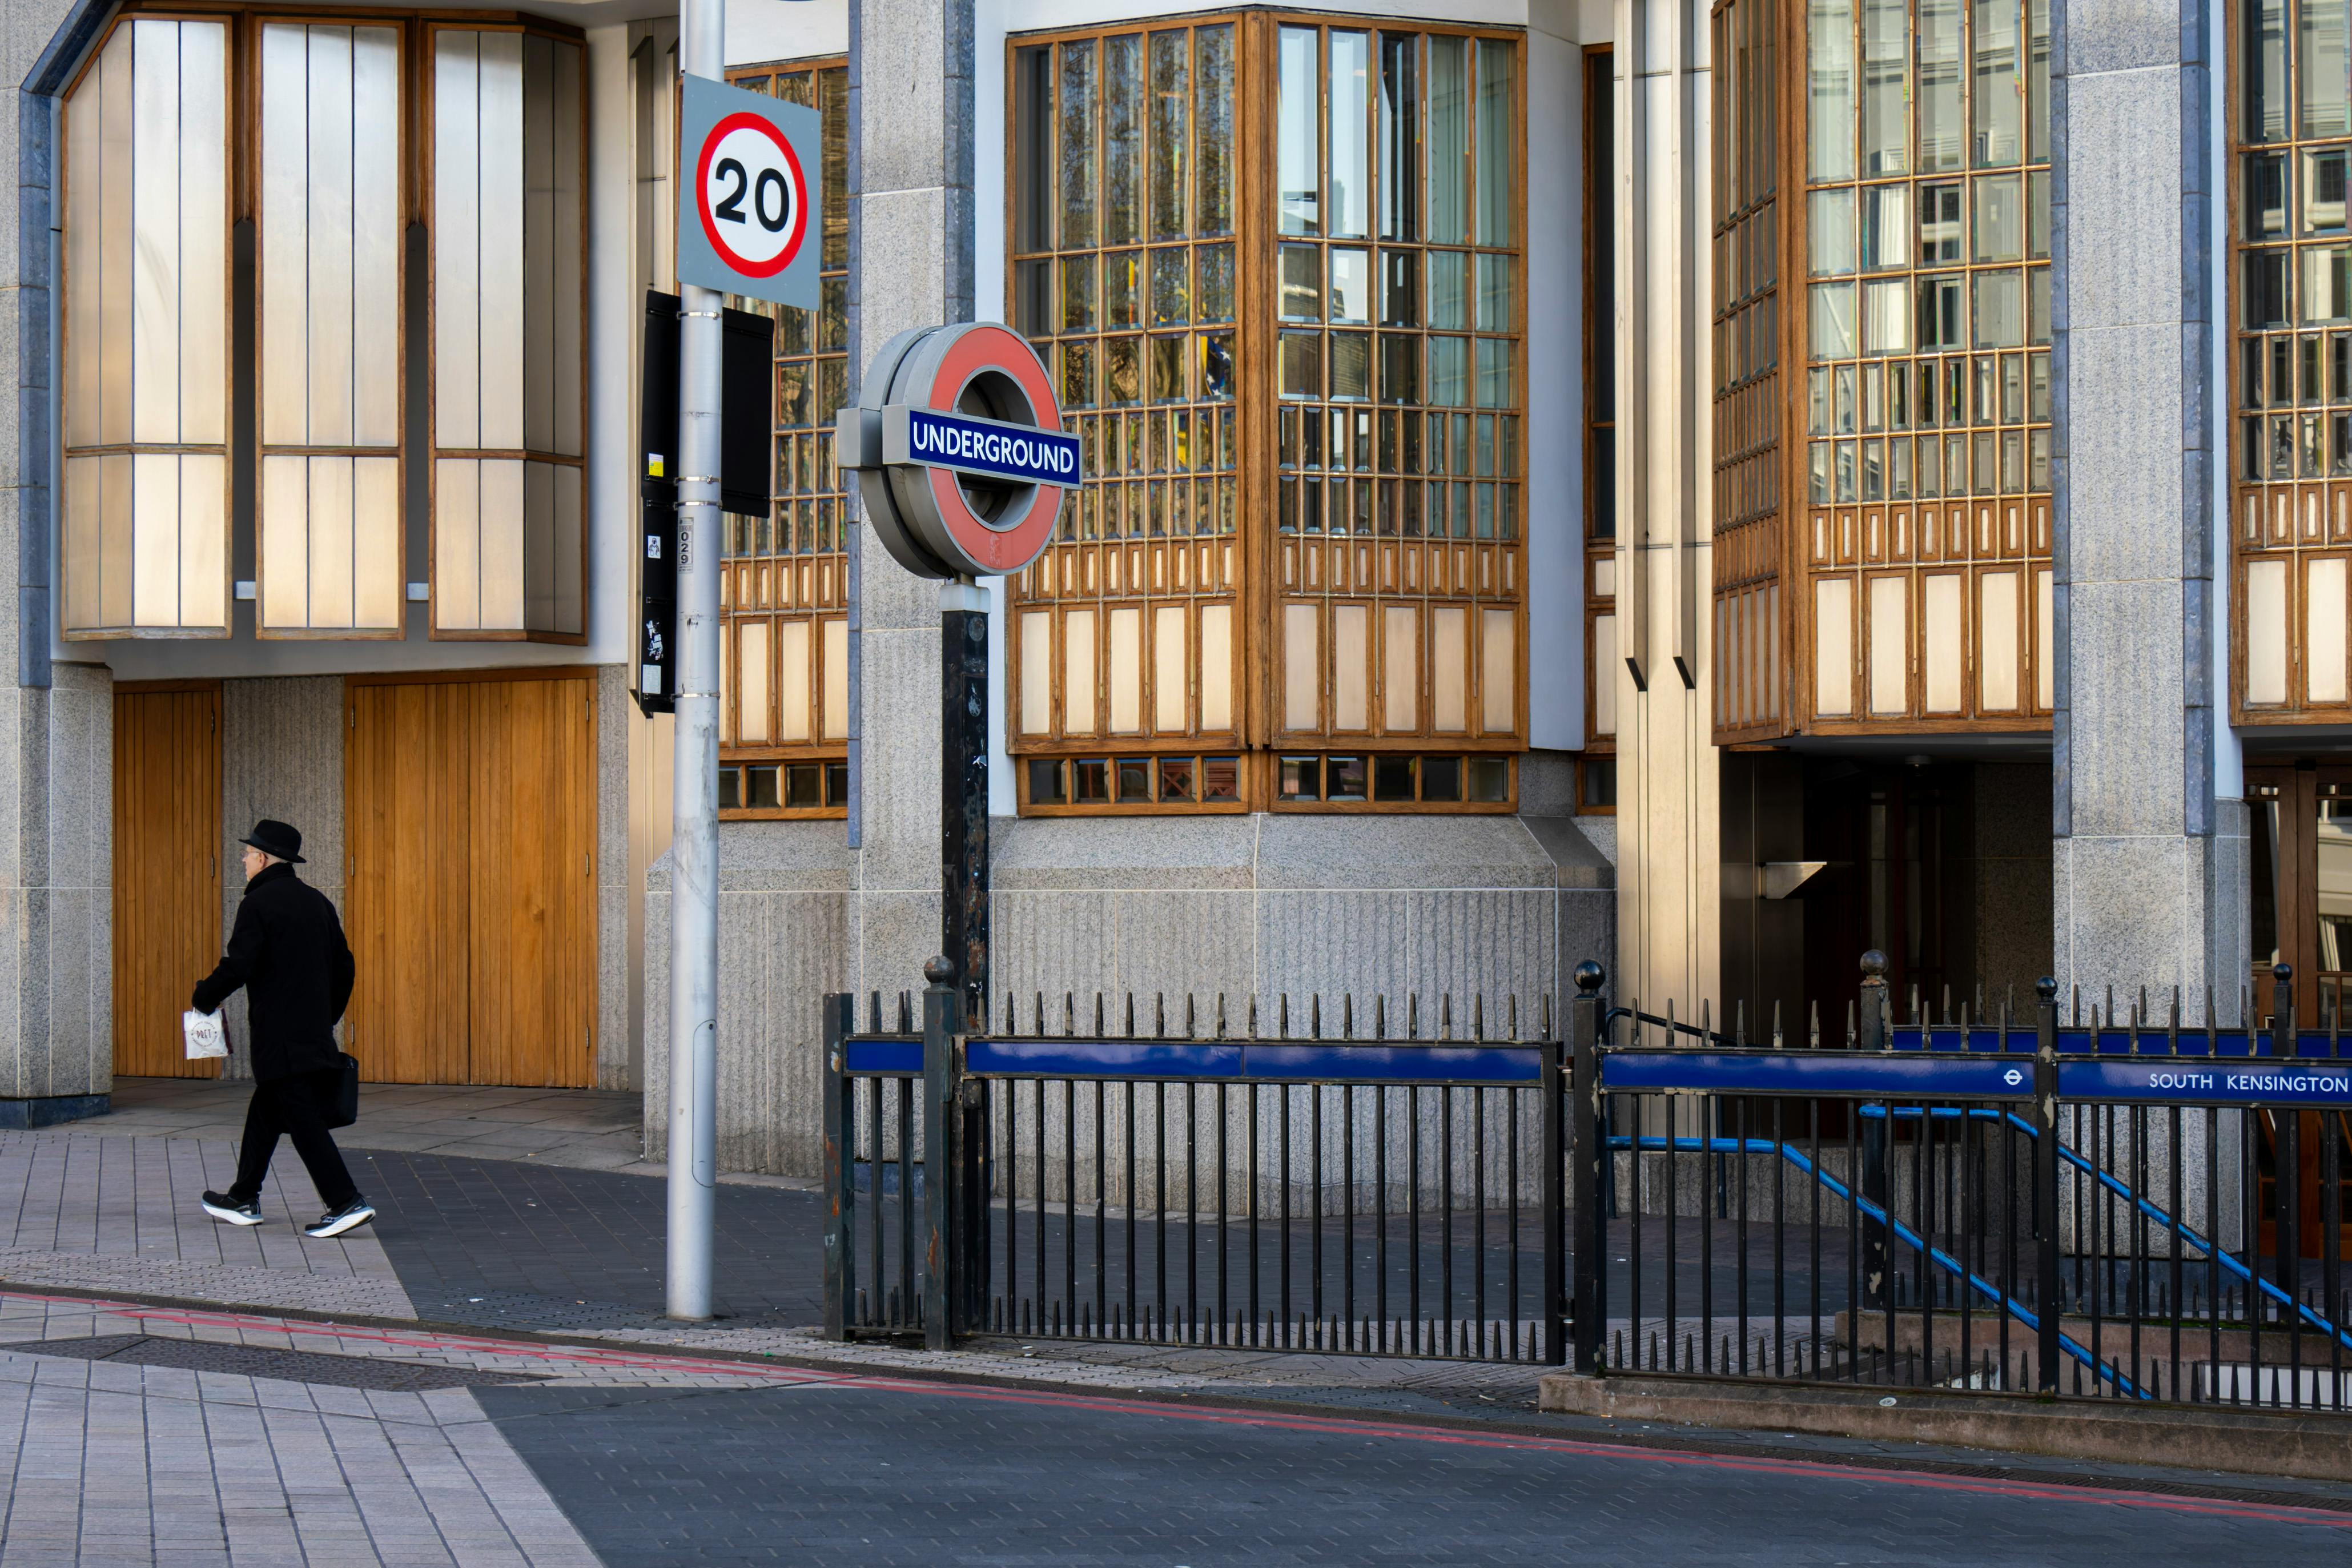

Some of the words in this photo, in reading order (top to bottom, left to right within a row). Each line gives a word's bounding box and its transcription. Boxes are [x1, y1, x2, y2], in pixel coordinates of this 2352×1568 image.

[715, 158, 790, 232] 20
[914, 421, 1074, 473] UNDERGROUND
[196, 1029, 211, 1039] PRET
[2149, 1073, 2213, 1089] SOUTH
[2227, 1075, 2349, 1092] KENSINGTON
